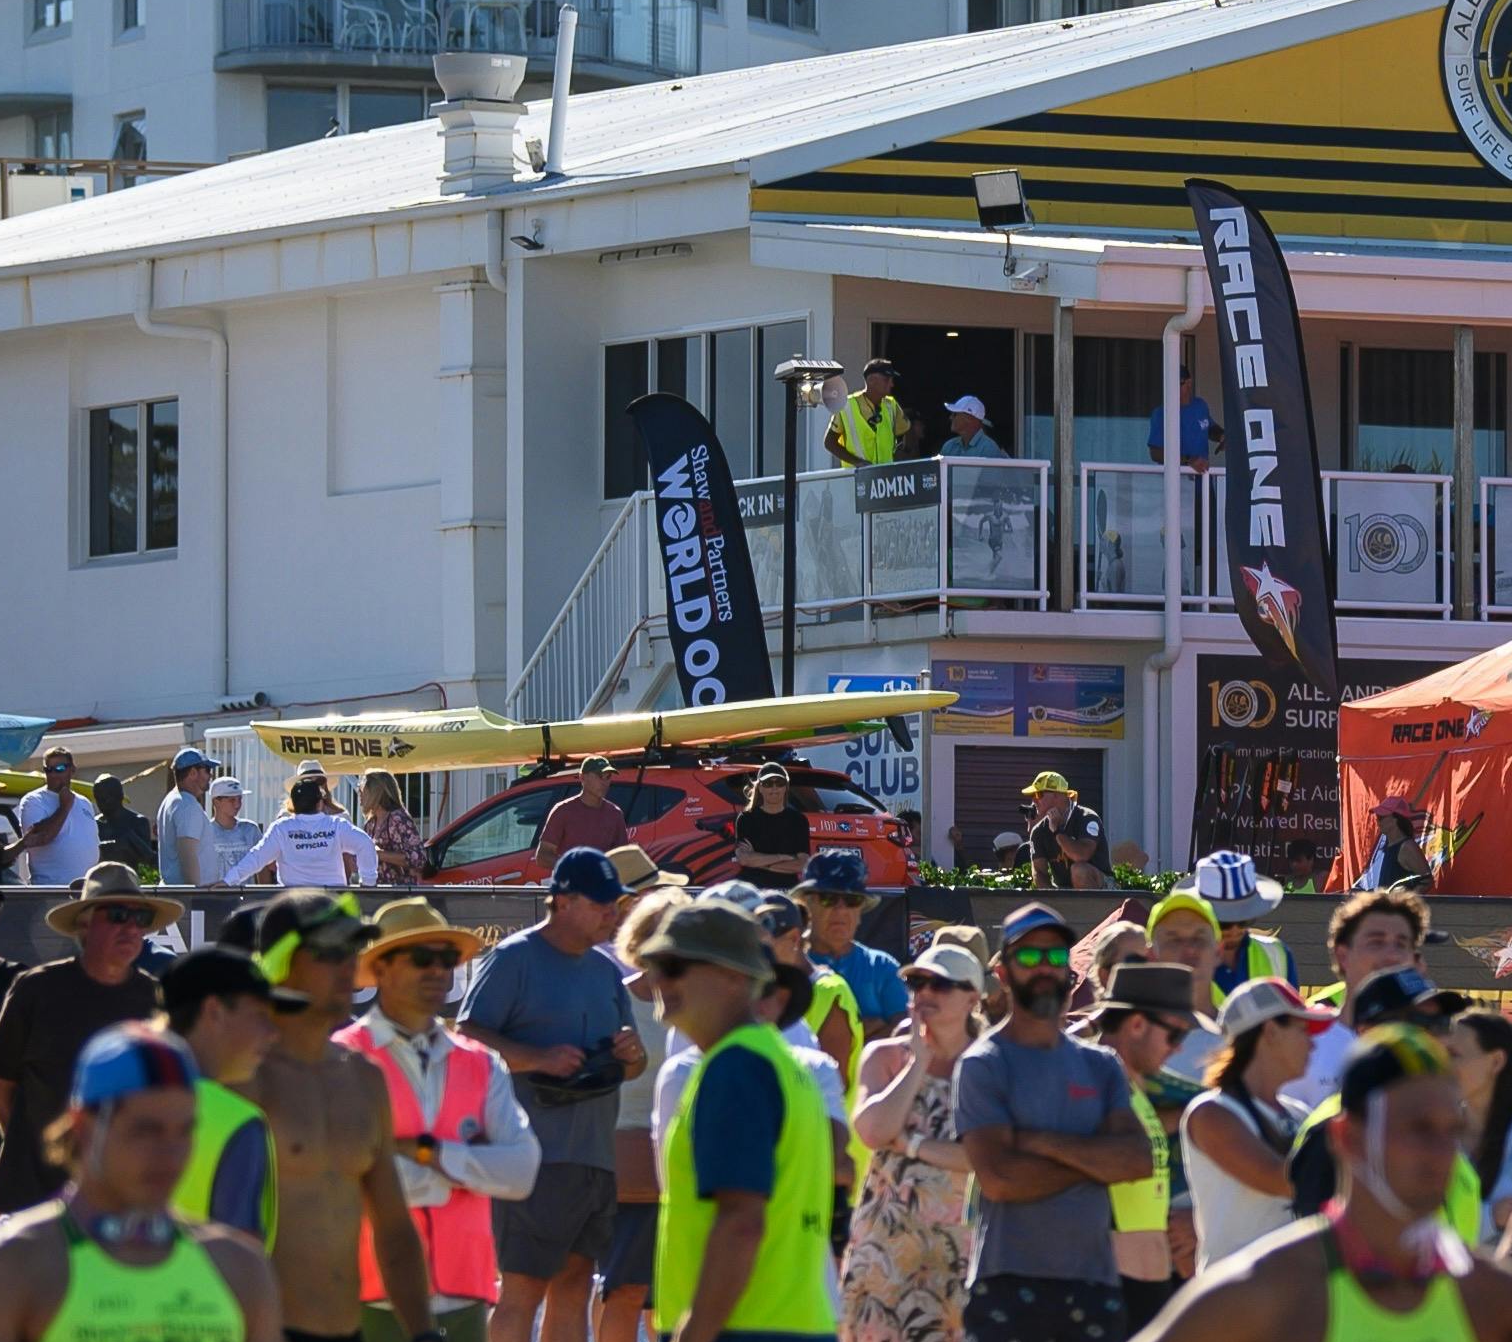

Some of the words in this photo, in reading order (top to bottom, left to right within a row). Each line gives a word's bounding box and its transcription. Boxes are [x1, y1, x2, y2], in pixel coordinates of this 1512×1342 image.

[1454, 63, 1476, 117] SURF
[1472, 119, 1505, 160] LIFE
[1209, 206, 1269, 389] RACE
[1243, 408, 1286, 548] ONE
[758, 492, 775, 516] IN
[868, 473, 916, 501] ADMIN
[657, 453, 713, 634] WORLD
[279, 734, 336, 756] RACE
[340, 737, 383, 758] ONE
[1391, 721, 1434, 744] RACE
[1434, 719, 1464, 742] ONE
[844, 756, 920, 797] CLUB
